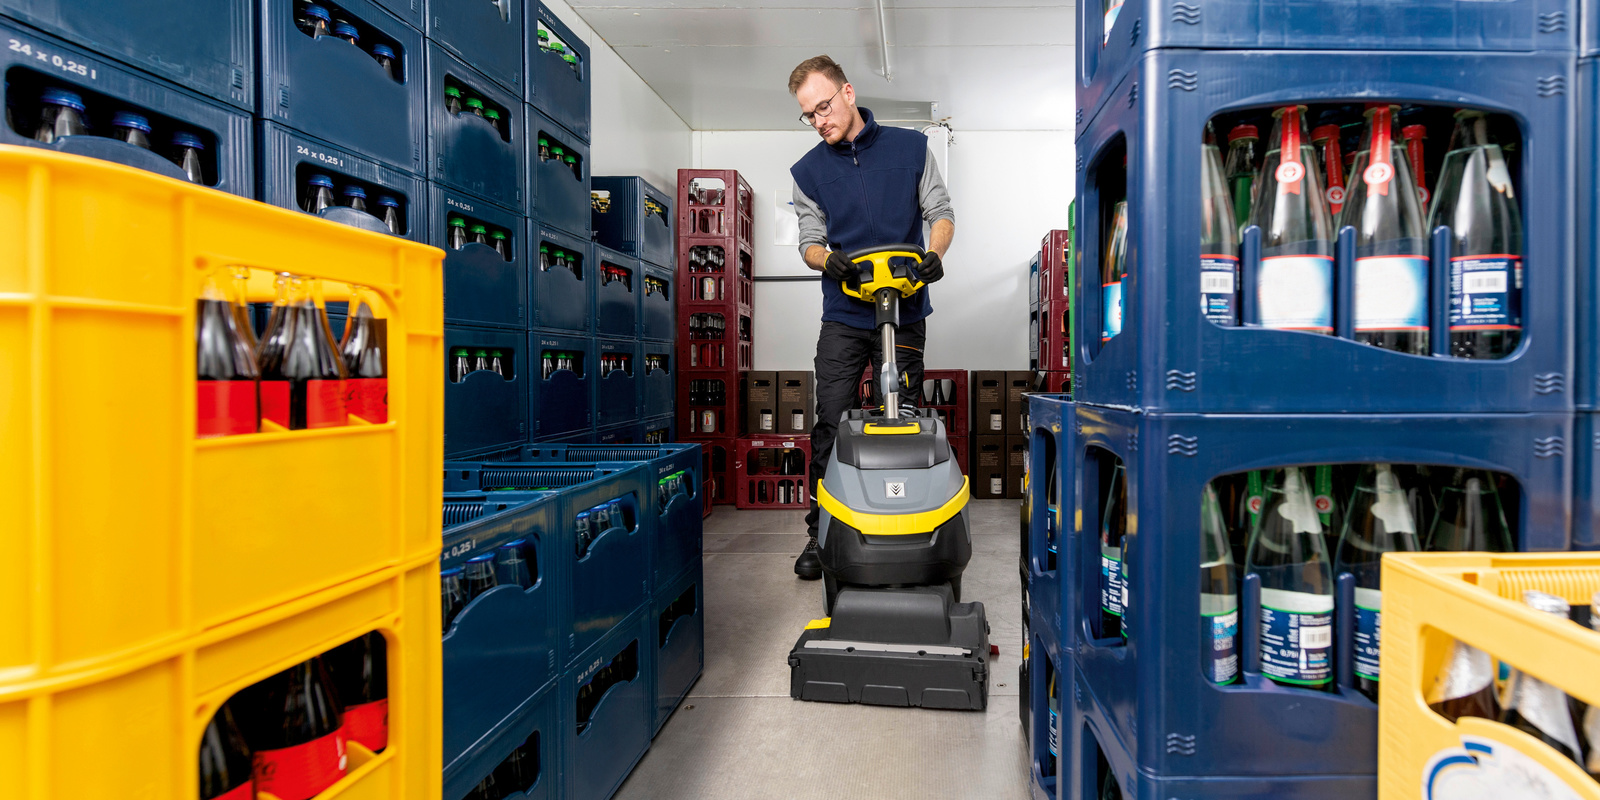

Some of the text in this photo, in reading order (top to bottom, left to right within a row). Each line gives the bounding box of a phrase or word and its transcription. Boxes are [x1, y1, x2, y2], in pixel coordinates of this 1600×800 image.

[8, 38, 97, 80] 24 x 0,25 l
[297, 145, 309, 156] 24
[311, 151, 317, 159] x
[319, 153, 338, 166] 0,25
[447, 198, 454, 206] 24
[459, 202, 470, 211] 0,25
[443, 551, 450, 561] x
[451, 541, 471, 557] 0,25
